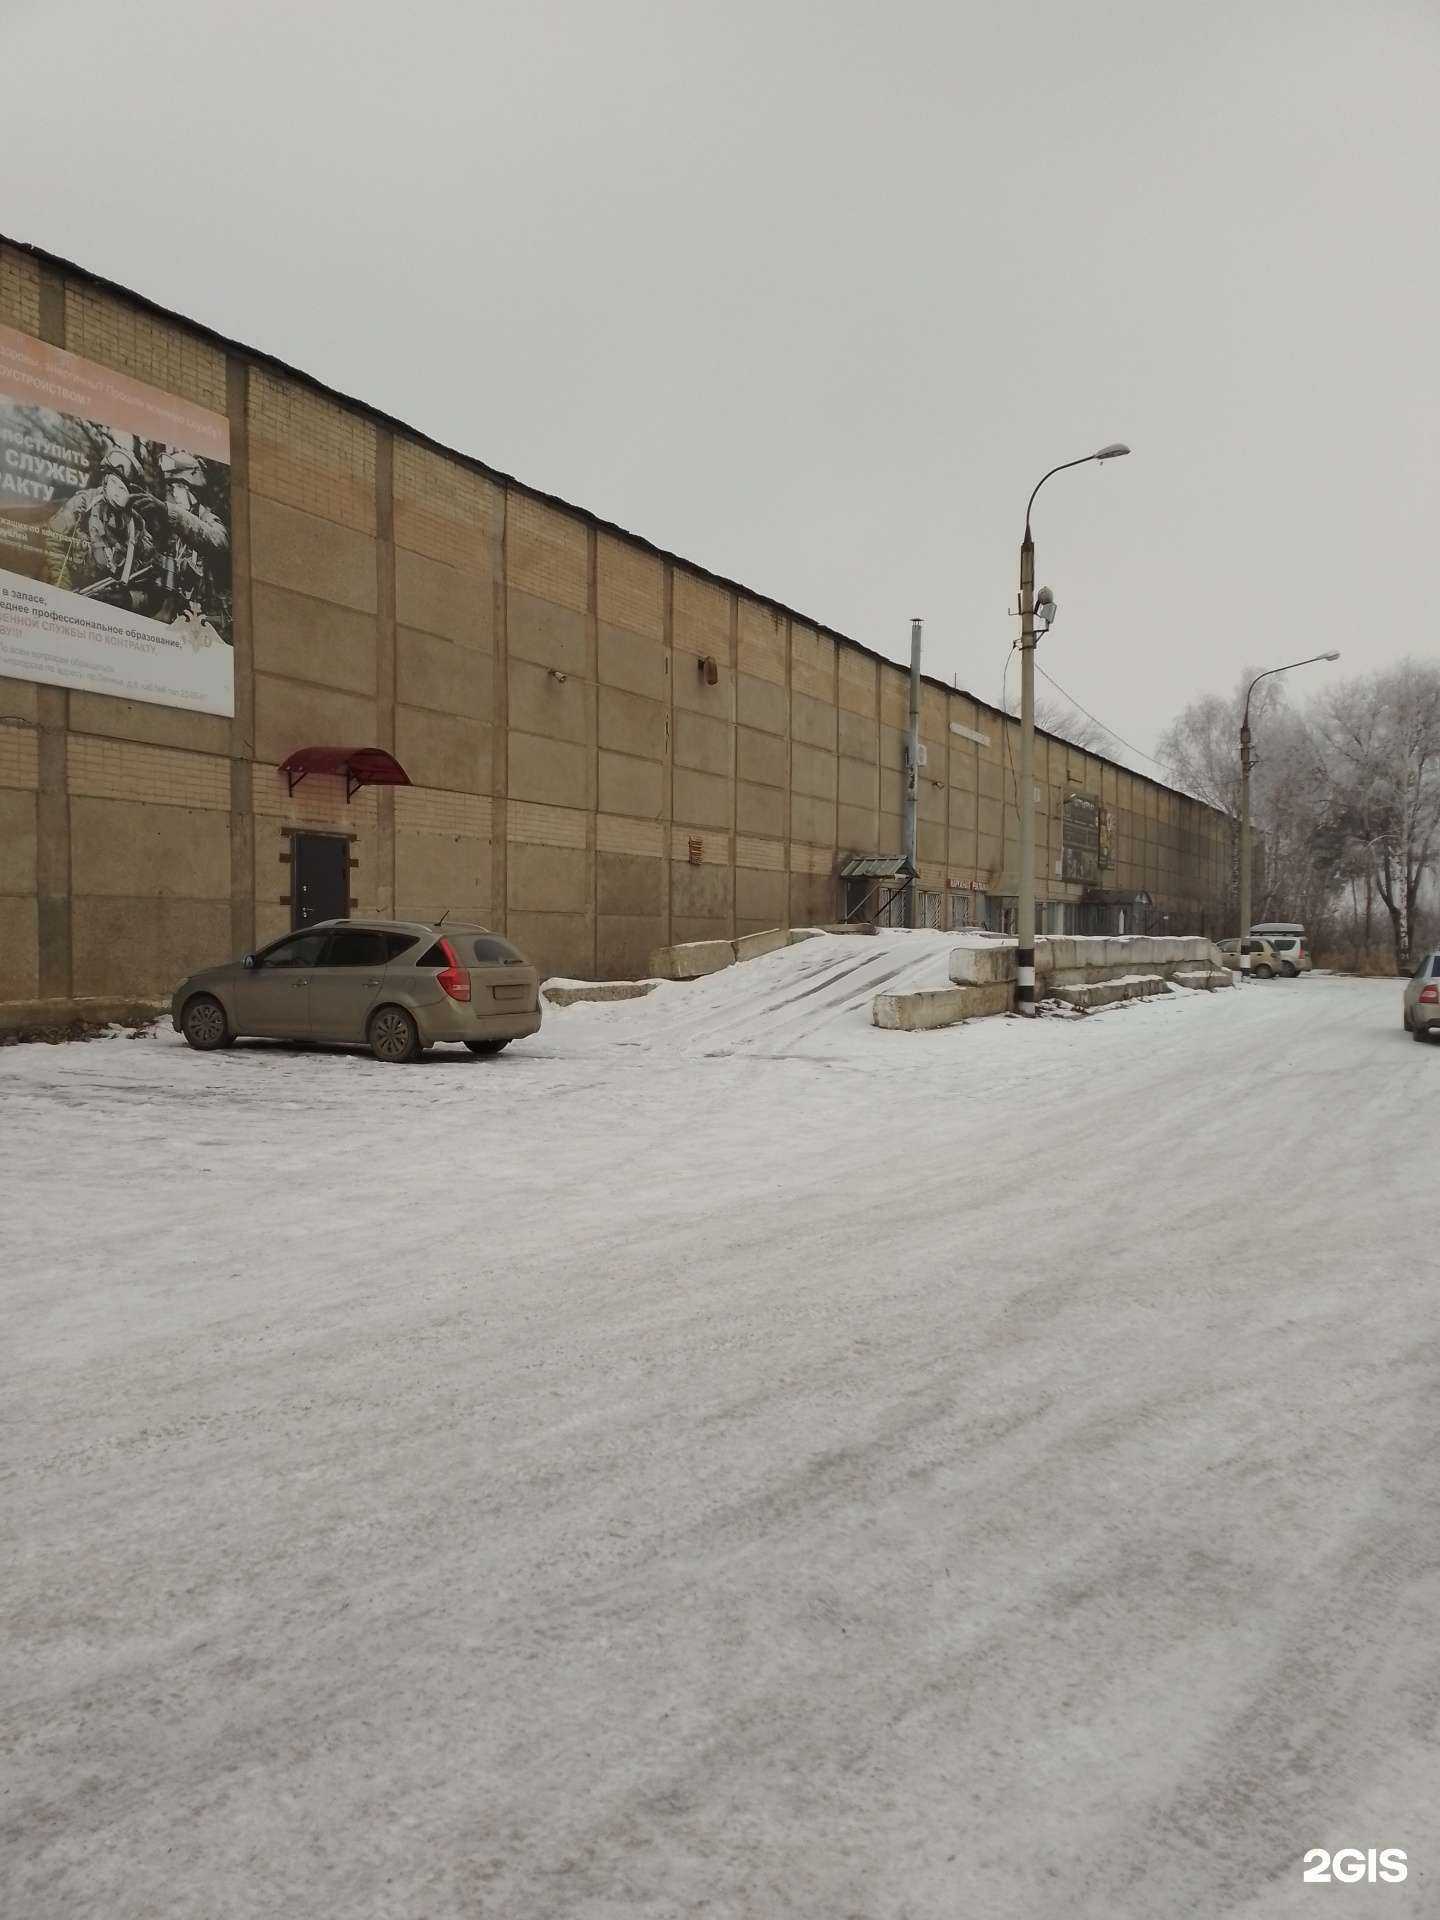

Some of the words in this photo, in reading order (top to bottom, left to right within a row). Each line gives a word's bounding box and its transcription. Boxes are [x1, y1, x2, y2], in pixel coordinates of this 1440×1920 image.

[5, 449, 91, 489] СЛУЖБУ
[0, 472, 55, 502] АКТУ
[32, 606, 124, 636] профессиональное
